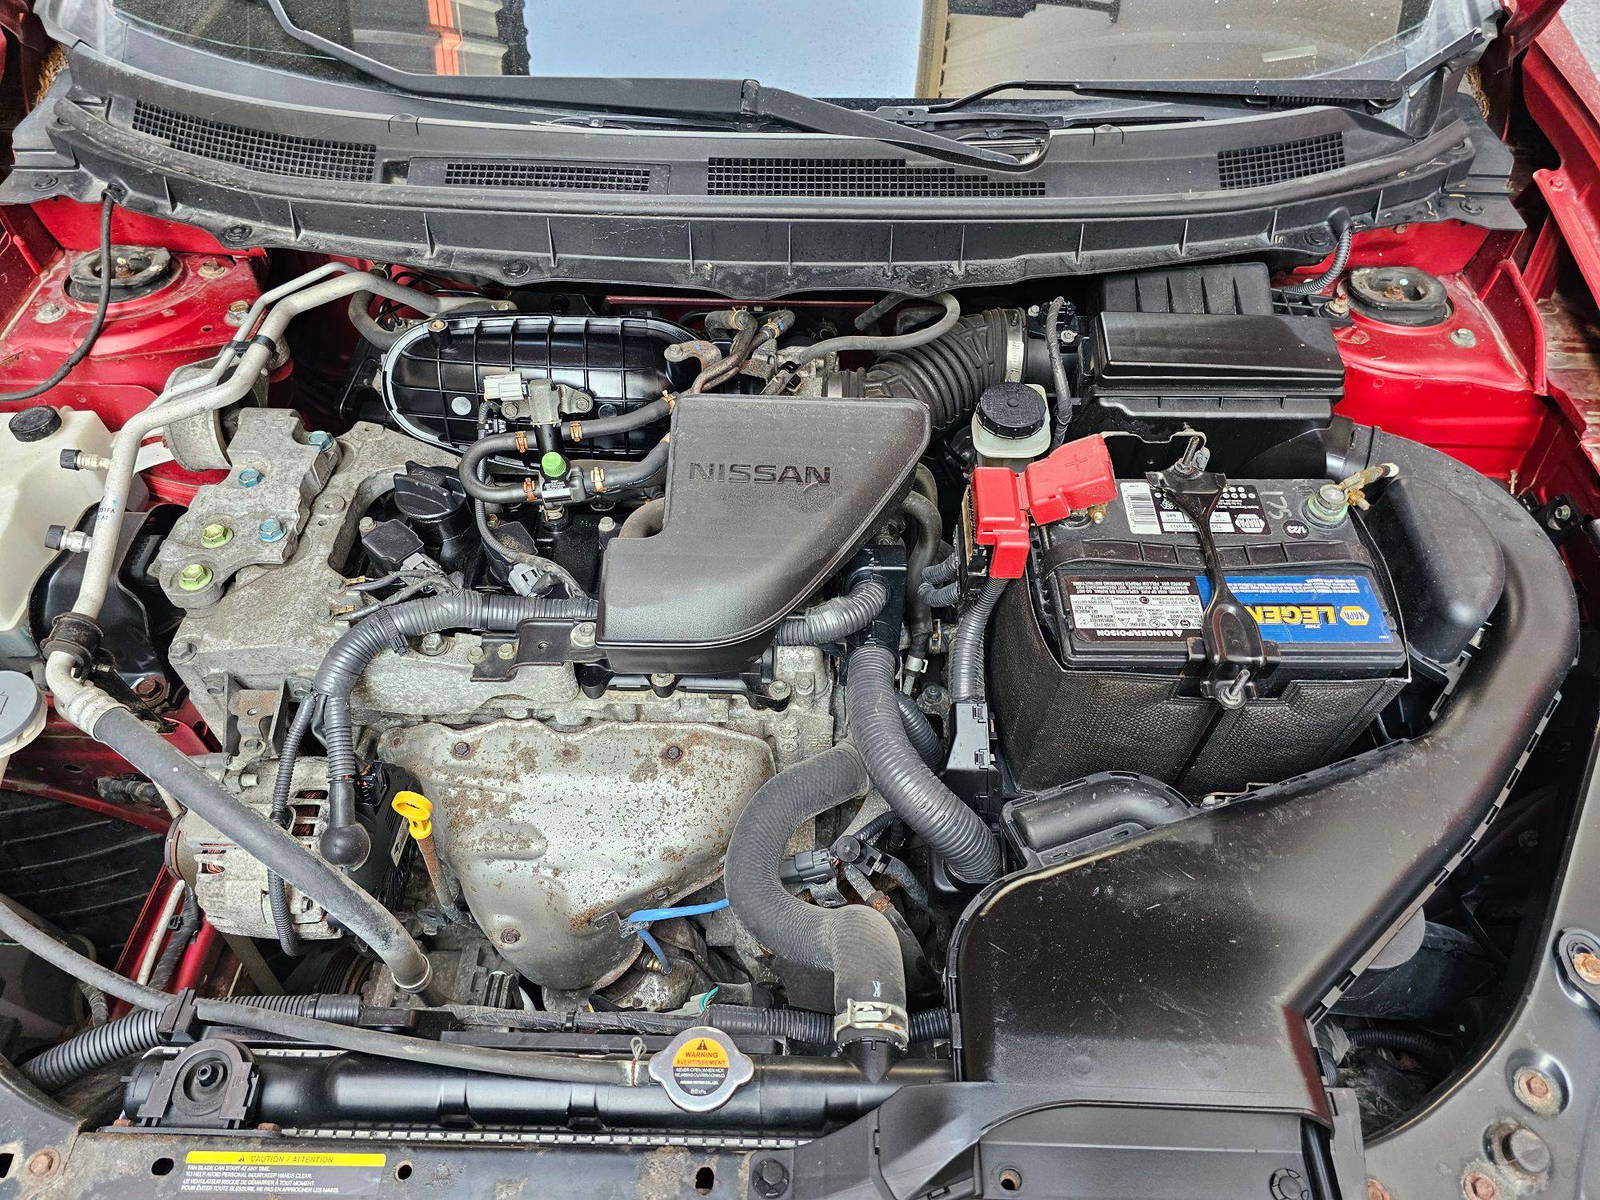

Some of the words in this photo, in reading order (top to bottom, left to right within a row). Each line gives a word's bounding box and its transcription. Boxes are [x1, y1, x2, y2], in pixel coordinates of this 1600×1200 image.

[689, 462, 831, 486] NISSAN
[1243, 604, 1337, 625] LEGEN
[685, 1051, 719, 1059] WARNING
[250, 1155, 285, 1163] CAUTION
[292, 1156, 334, 1164] ATTENTION
